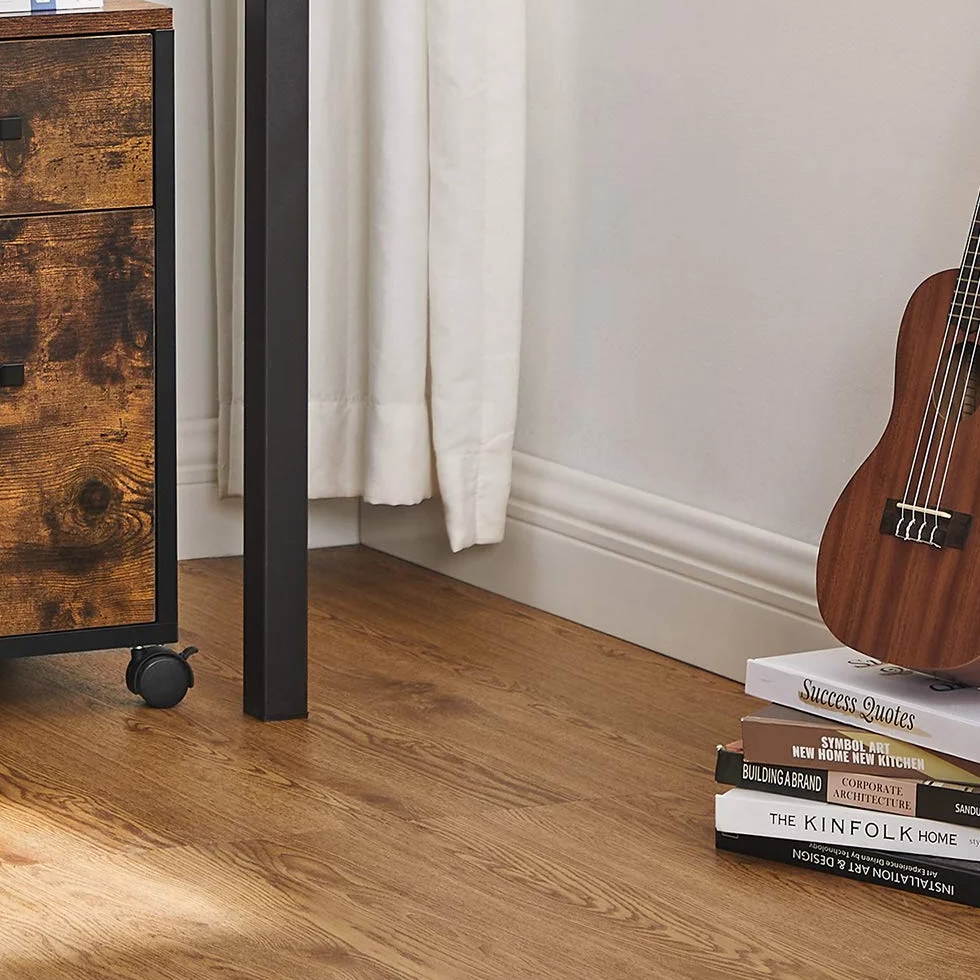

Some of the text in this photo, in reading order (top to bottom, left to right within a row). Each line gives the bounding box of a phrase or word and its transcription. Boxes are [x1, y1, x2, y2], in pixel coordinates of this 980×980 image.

[800, 678, 916, 730] Success Quotes
[792, 745, 925, 770] NEW HOME NEW KITCHEN
[821, 736, 890, 754] SYMBOL ART
[841, 777, 903, 797] CORPORATE
[833, 789, 912, 811] ARCHITECTURE
[955, 803, 980, 816] SANDU
[770, 812, 796, 826] THE
[804, 815, 913, 842] KINFOLK
[918, 830, 957, 846] HOME
[793, 849, 954, 896] INSTALLATION ART & DESIGN
[808, 842, 938, 878] Art Experience Driven by Technology
